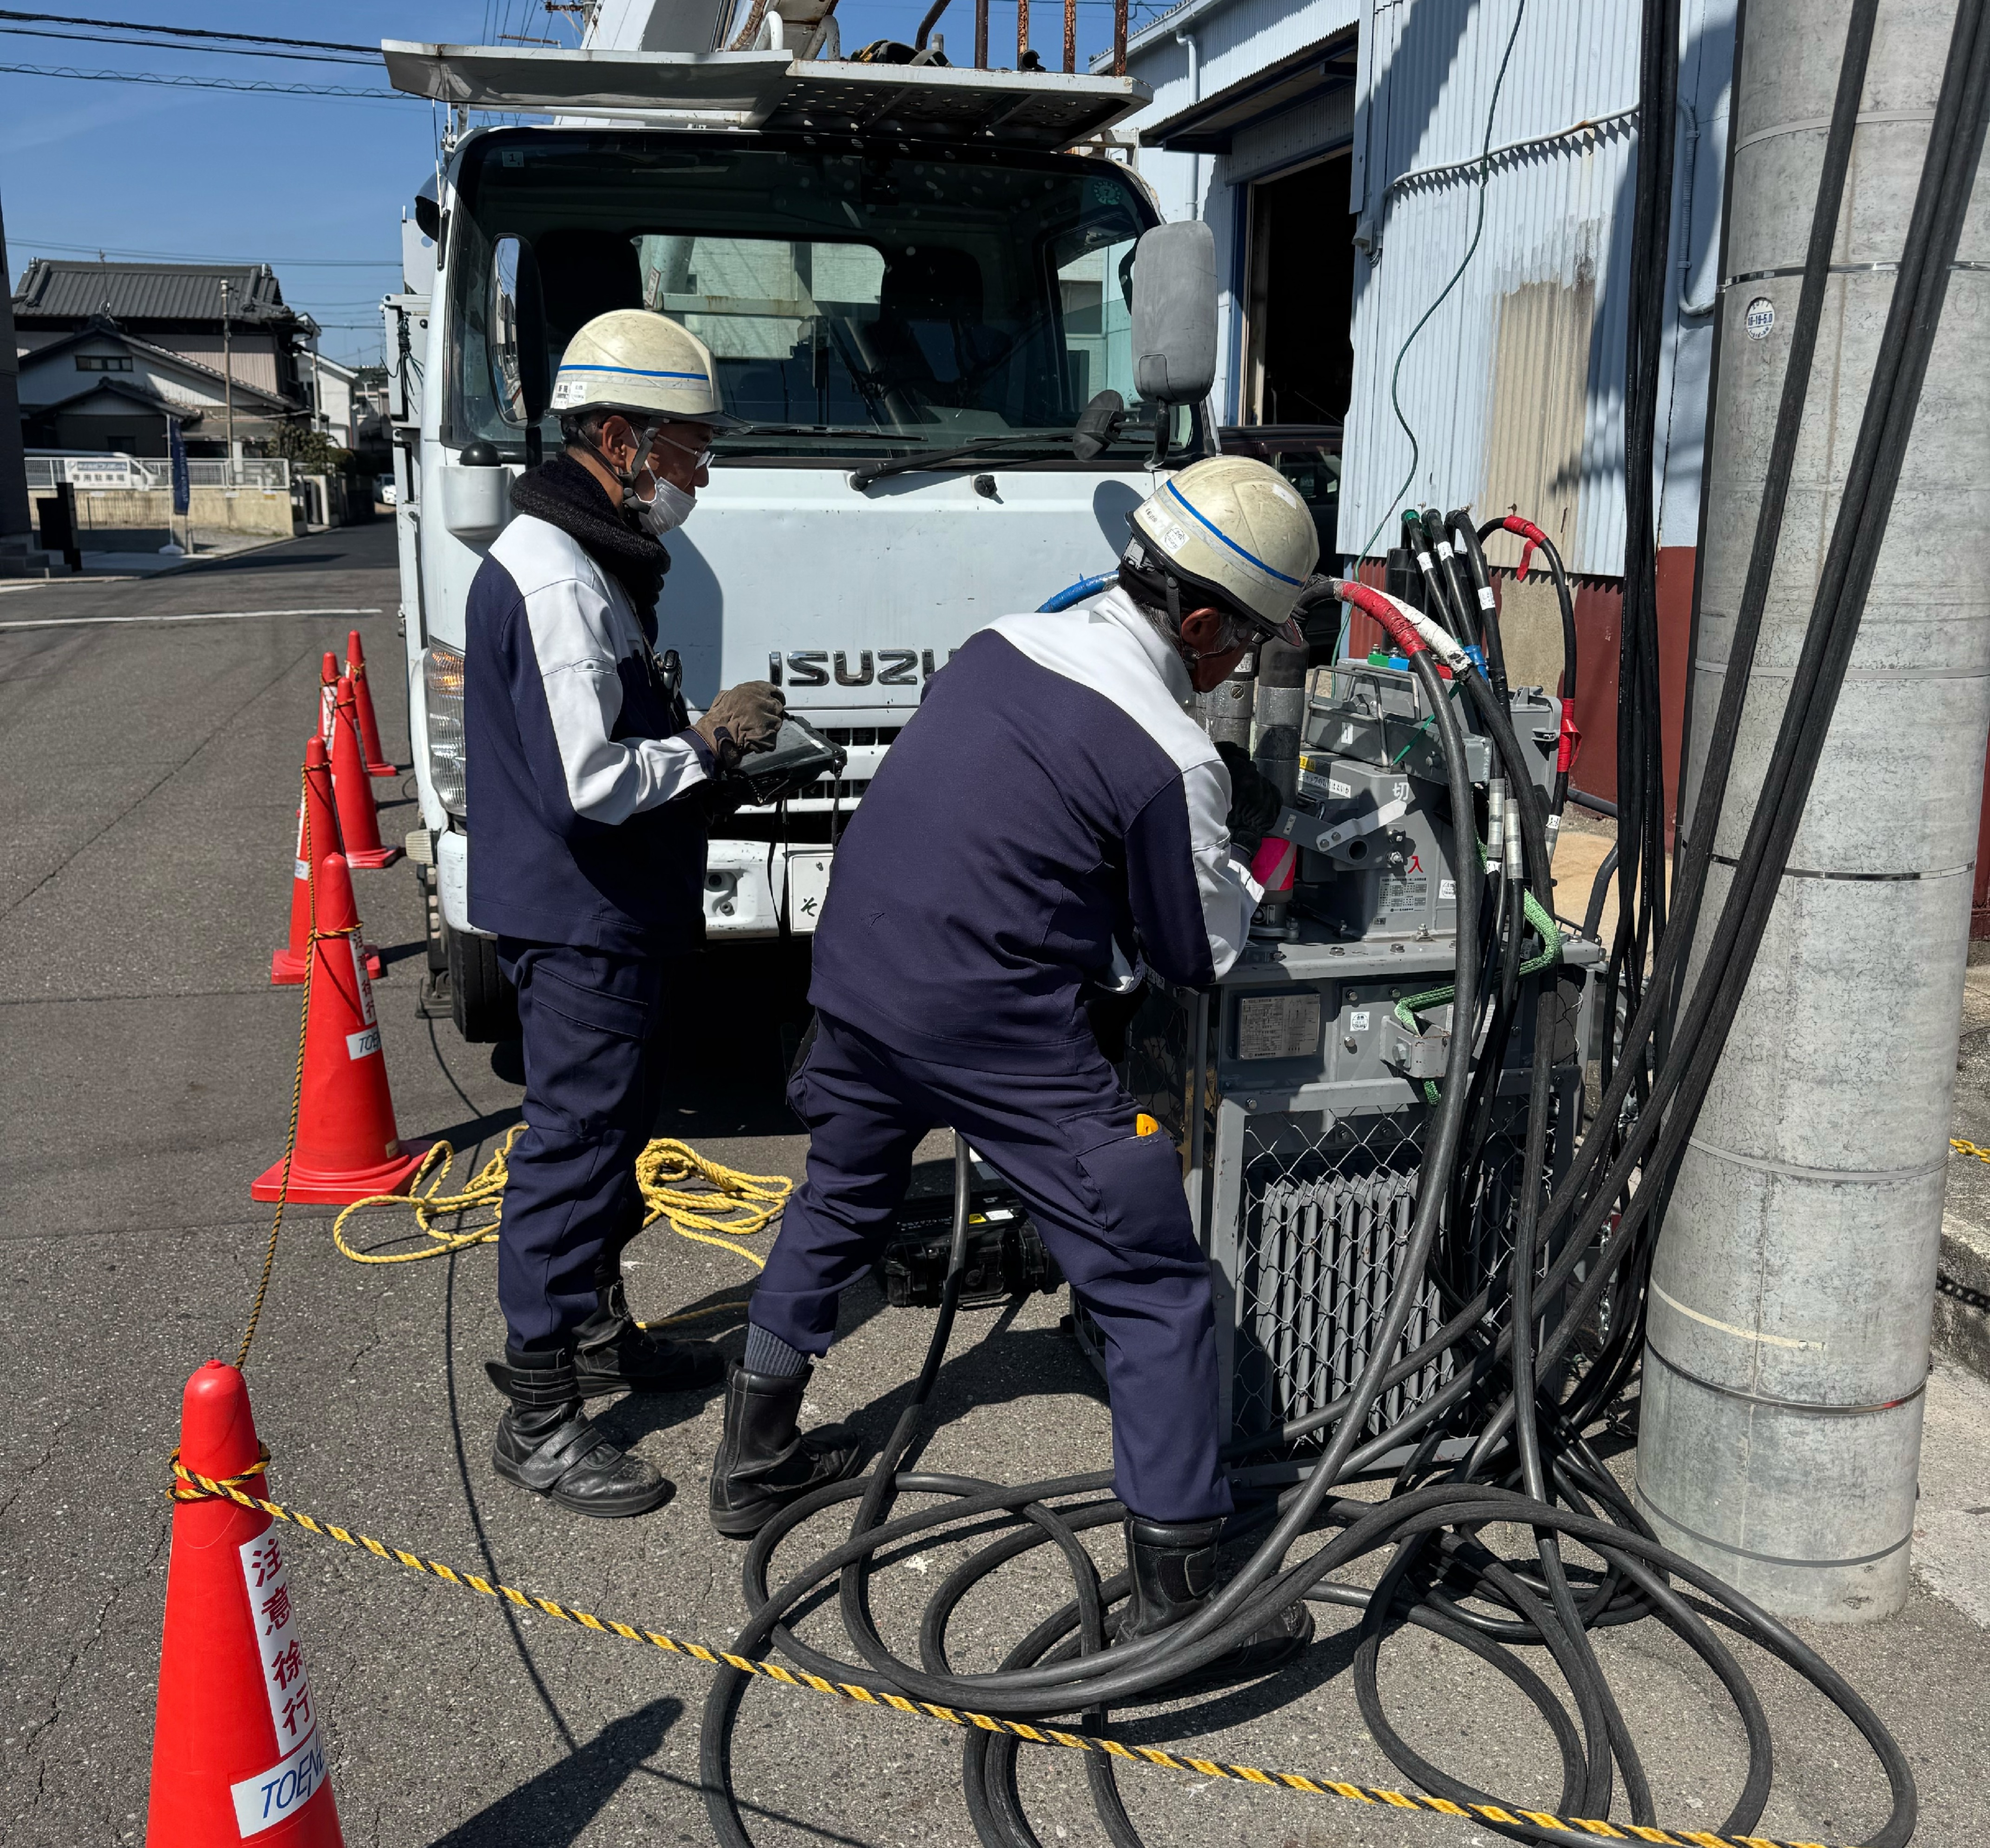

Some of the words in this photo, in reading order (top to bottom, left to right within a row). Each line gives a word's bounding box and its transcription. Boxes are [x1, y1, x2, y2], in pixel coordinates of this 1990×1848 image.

[1392, 782, 1409, 800] 切
[1407, 856, 1424, 874] 入
[251, 1538, 310, 1737] 注意徐行
